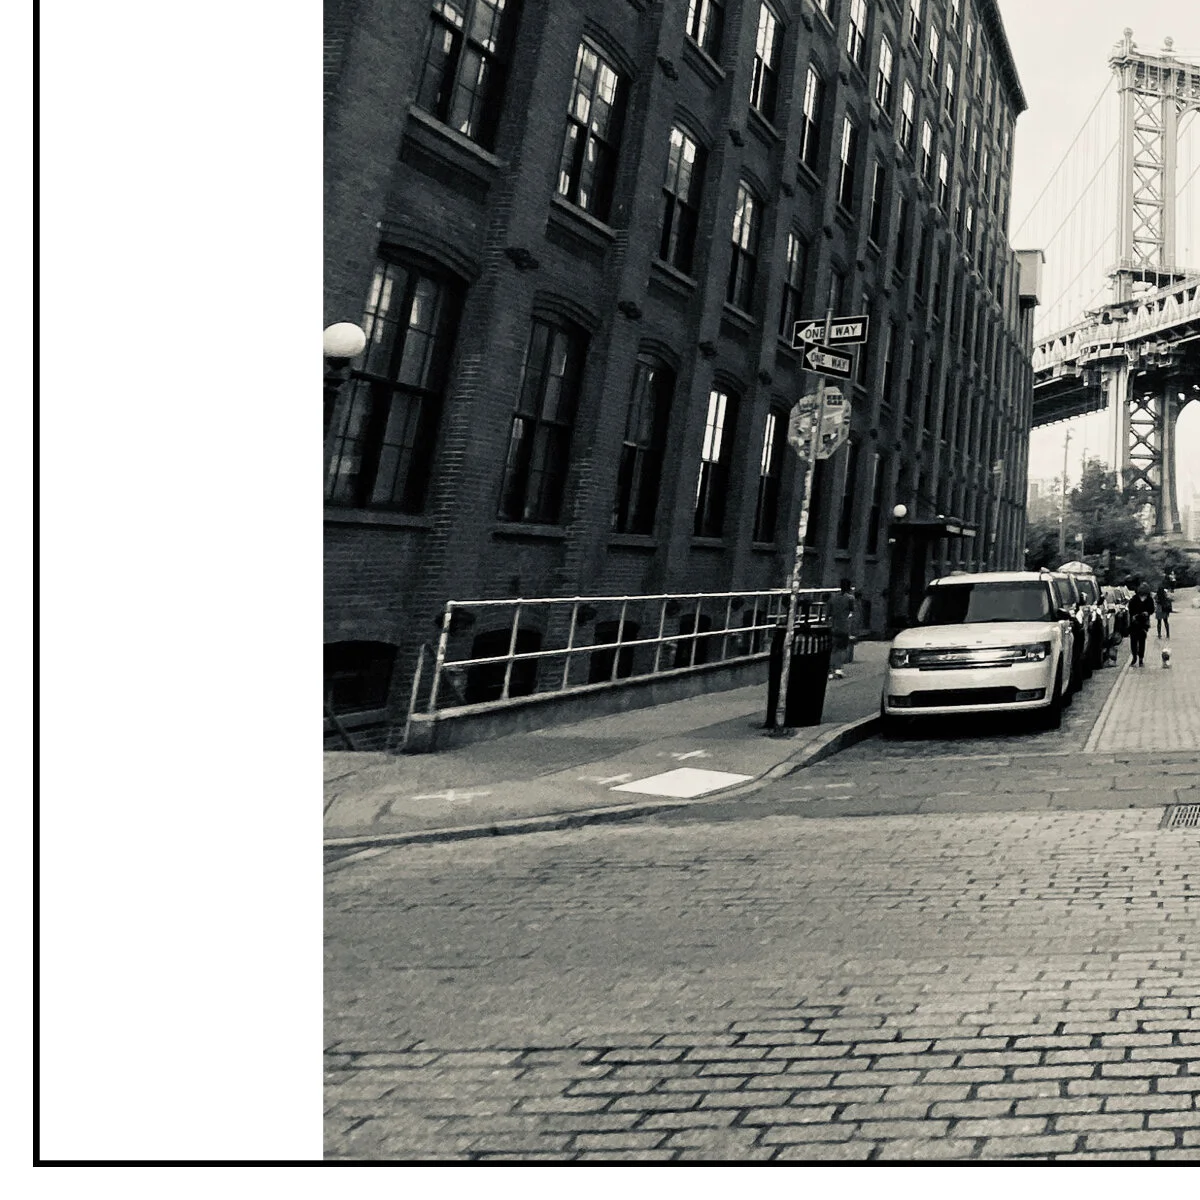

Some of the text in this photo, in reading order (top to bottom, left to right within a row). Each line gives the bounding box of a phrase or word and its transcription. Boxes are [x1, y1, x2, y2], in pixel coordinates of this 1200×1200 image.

[805, 325, 858, 339] ONE WAY
[811, 352, 848, 369] ONE WAY
